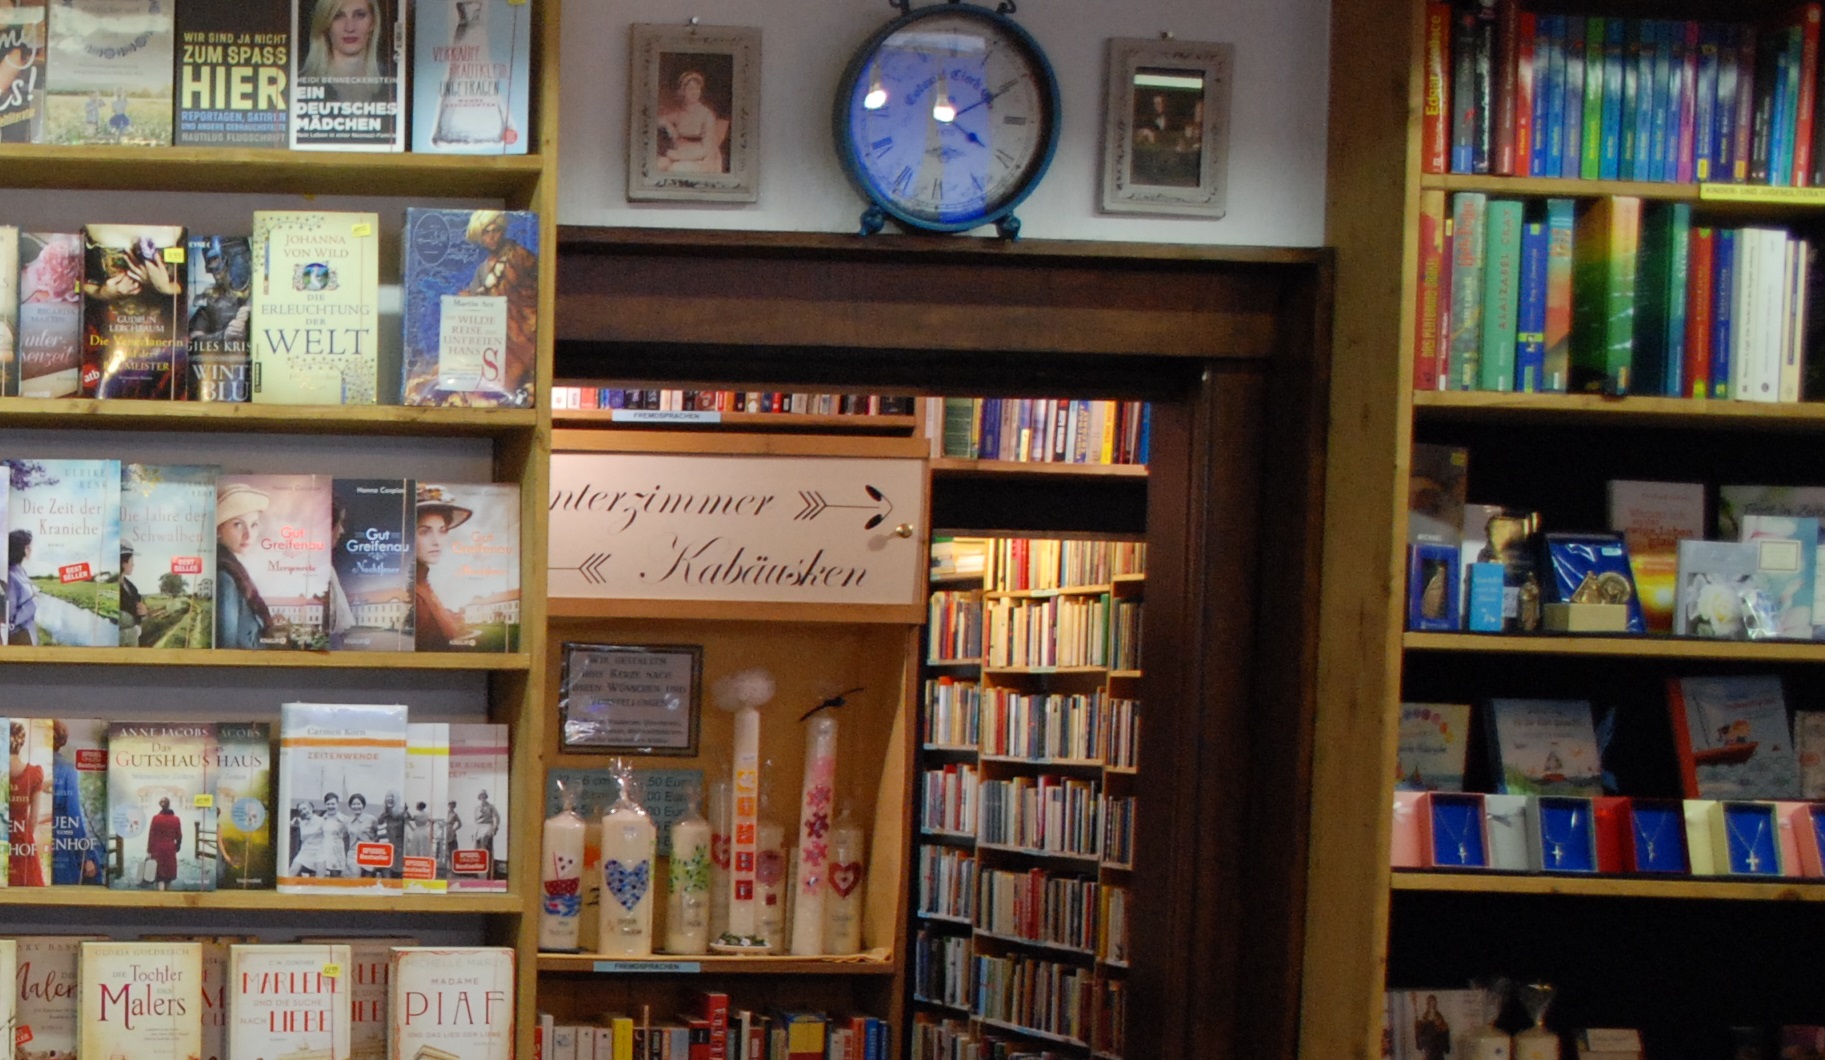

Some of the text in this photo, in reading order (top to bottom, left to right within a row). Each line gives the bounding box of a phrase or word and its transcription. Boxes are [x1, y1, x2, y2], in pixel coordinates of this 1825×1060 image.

[183, 31, 287, 45] WIR SIND JA NICHT
[183, 46, 287, 65] ZUM SPASS
[181, 65, 286, 110] HIER
[296, 86, 325, 101] EIN
[295, 102, 399, 117] DEUTSCHES
[295, 116, 382, 132] MÄDCHEN
[284, 234, 346, 246] JOHANNA
[283, 247, 349, 258] VON WILD
[261, 304, 370, 317] ERLEUCHTUNG
[263, 328, 370, 356] WELT
[83, 369, 101, 382] atb
[22, 498, 103, 516] Die Zeit der
[547, 483, 776, 534] nterzimmer
[119, 506, 181, 524] Die Jahre
[38, 518, 100, 537] Kraniche
[132, 526, 205, 544] Schwalben
[279, 526, 304, 540] Gut
[365, 527, 390, 542] Gut
[260, 538, 324, 551] Greifenau
[470, 531, 494, 544] Gut
[345, 538, 410, 553] Greifenau
[177, 557, 197, 566] BEST
[639, 536, 867, 588] Kabäusken
[63, 571, 88, 582] SELLER
[65, 564, 84, 575] BEST
[119, 726, 210, 737] ANNE JACOBS
[151, 742, 173, 753] Das
[114, 751, 211, 768] GUTSHAUS
[130, 964, 184, 984] Tochter
[431, 977, 480, 986] MADAME
[97, 983, 187, 1031] Malers
[405, 991, 505, 1026] PIAF
[269, 1010, 332, 1033] LIEBE
